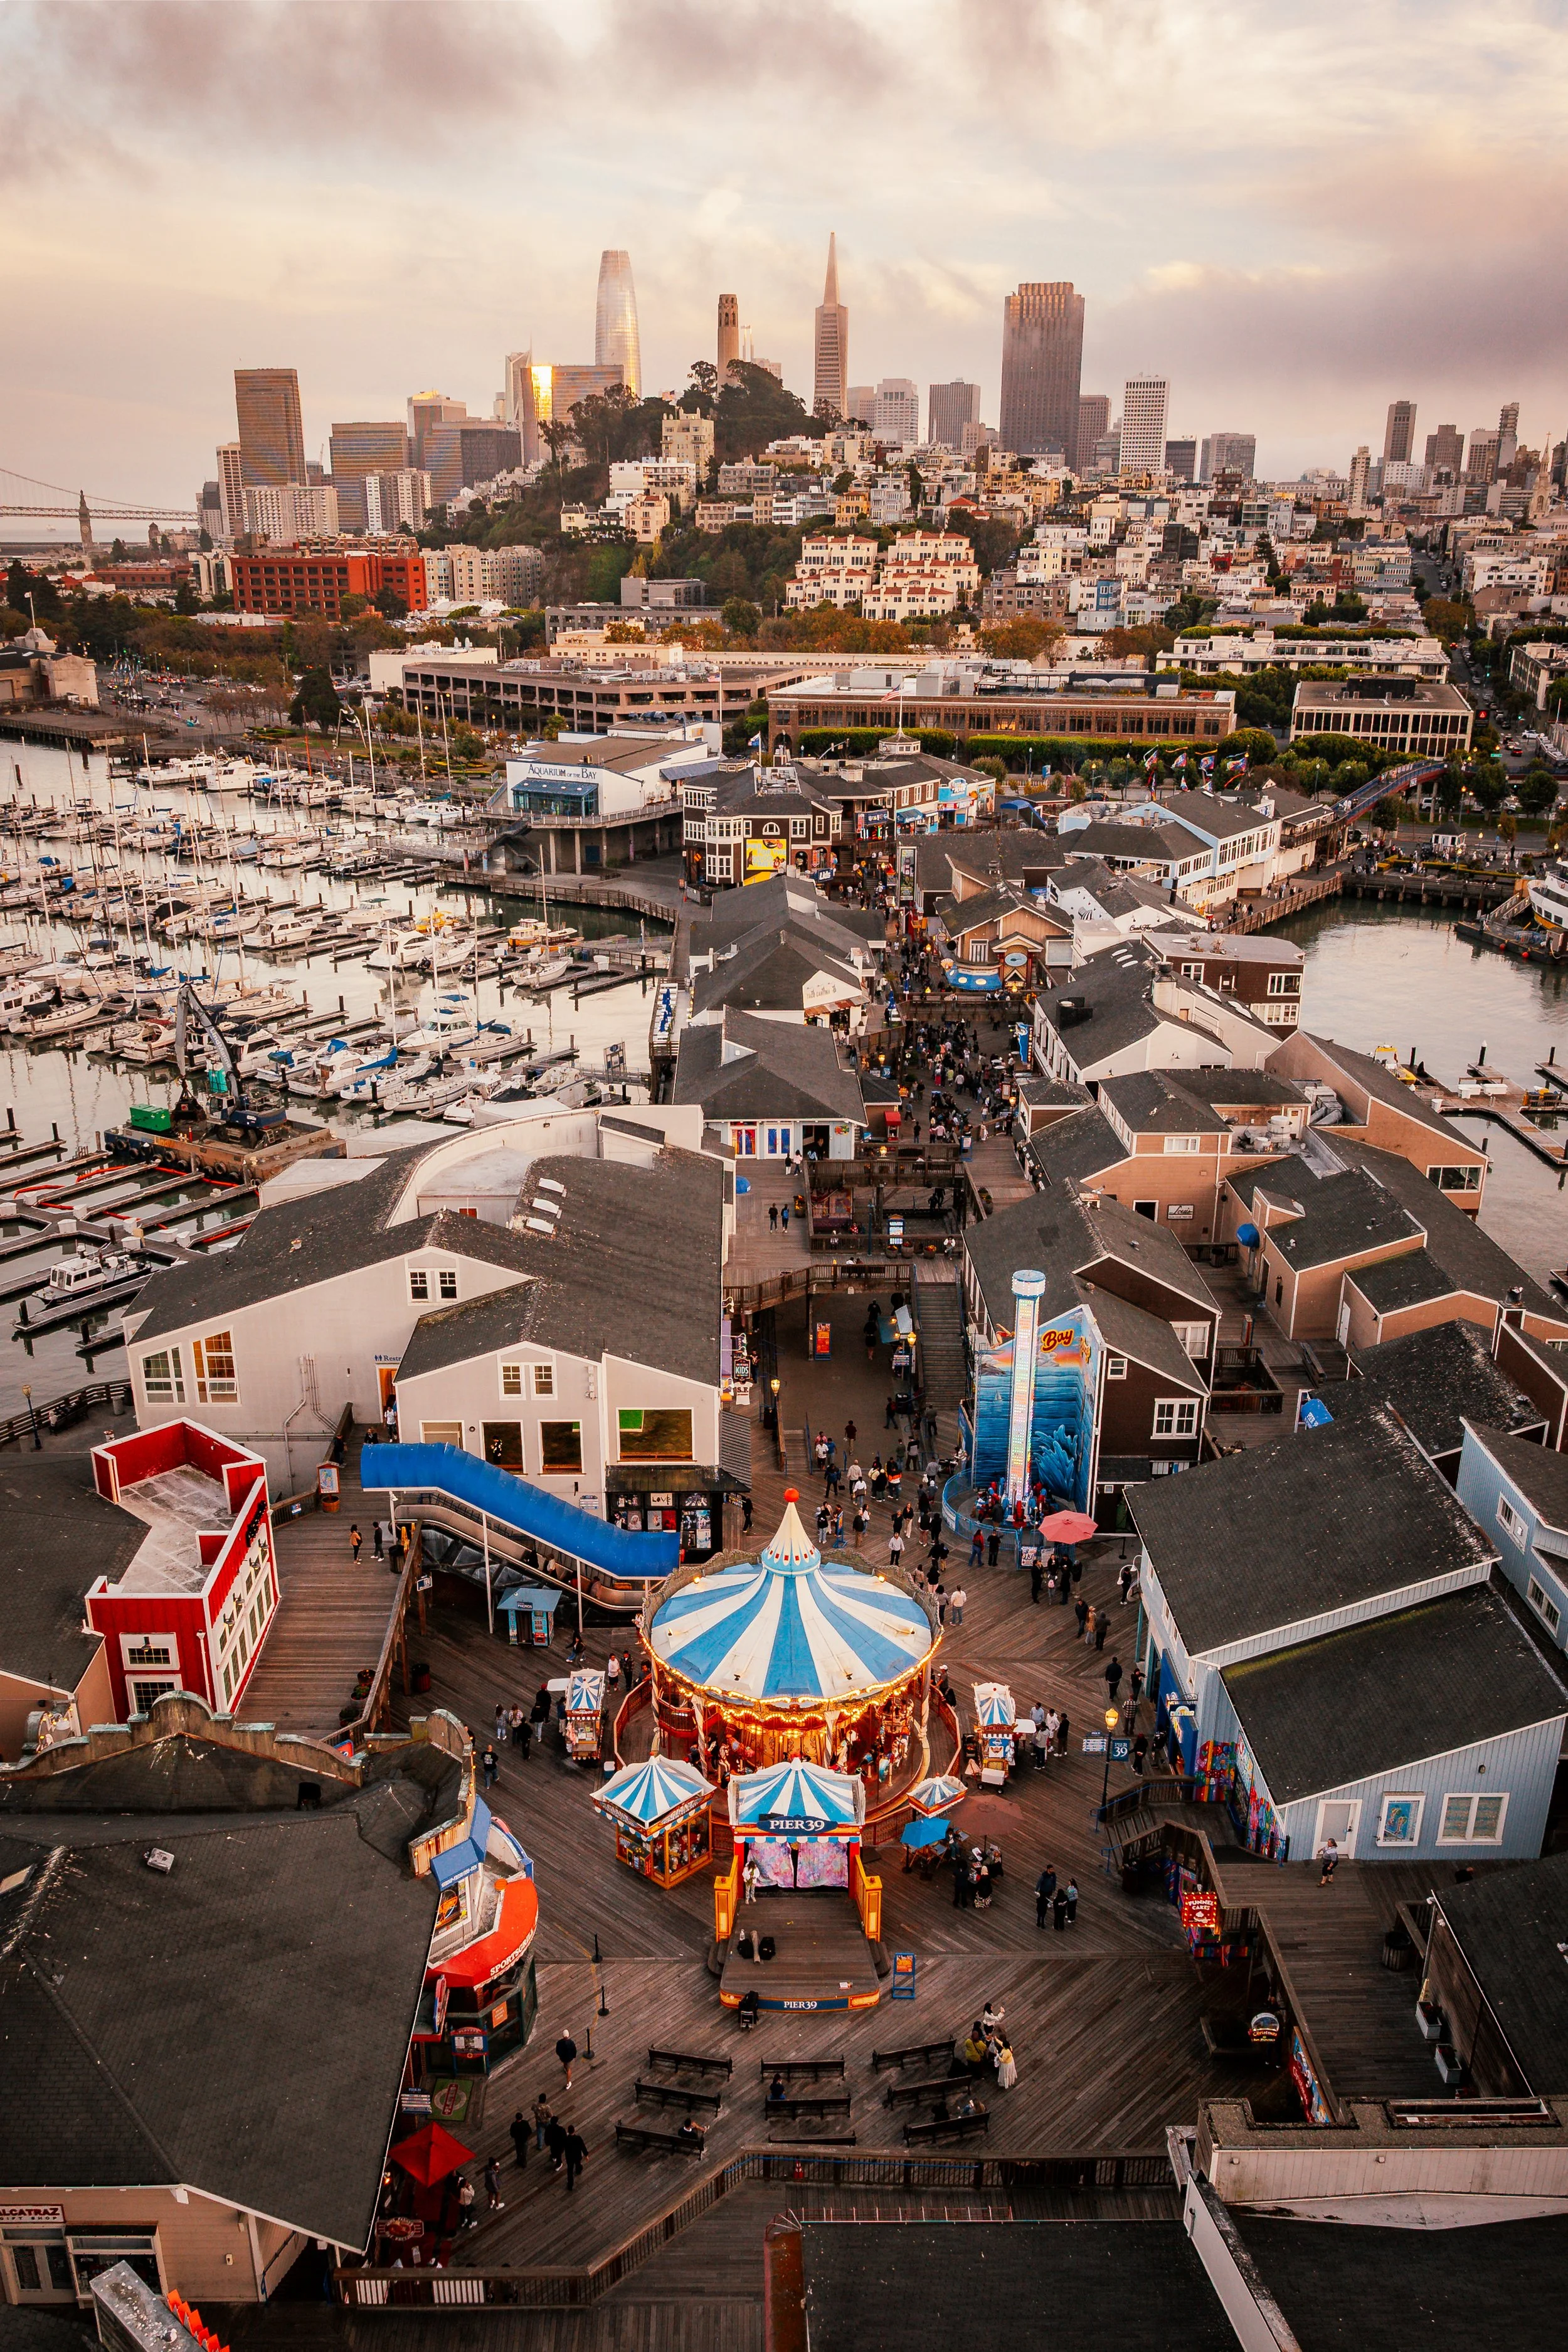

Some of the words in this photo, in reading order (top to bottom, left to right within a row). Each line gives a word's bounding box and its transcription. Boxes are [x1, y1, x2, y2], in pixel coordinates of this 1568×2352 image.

[528, 764, 566, 777] AQUARIUM
[581, 768, 596, 779] BAY
[1041, 1329, 1074, 1353] Bay
[652, 1495, 671, 1505] LOVE
[1113, 1747, 1128, 1757] 39
